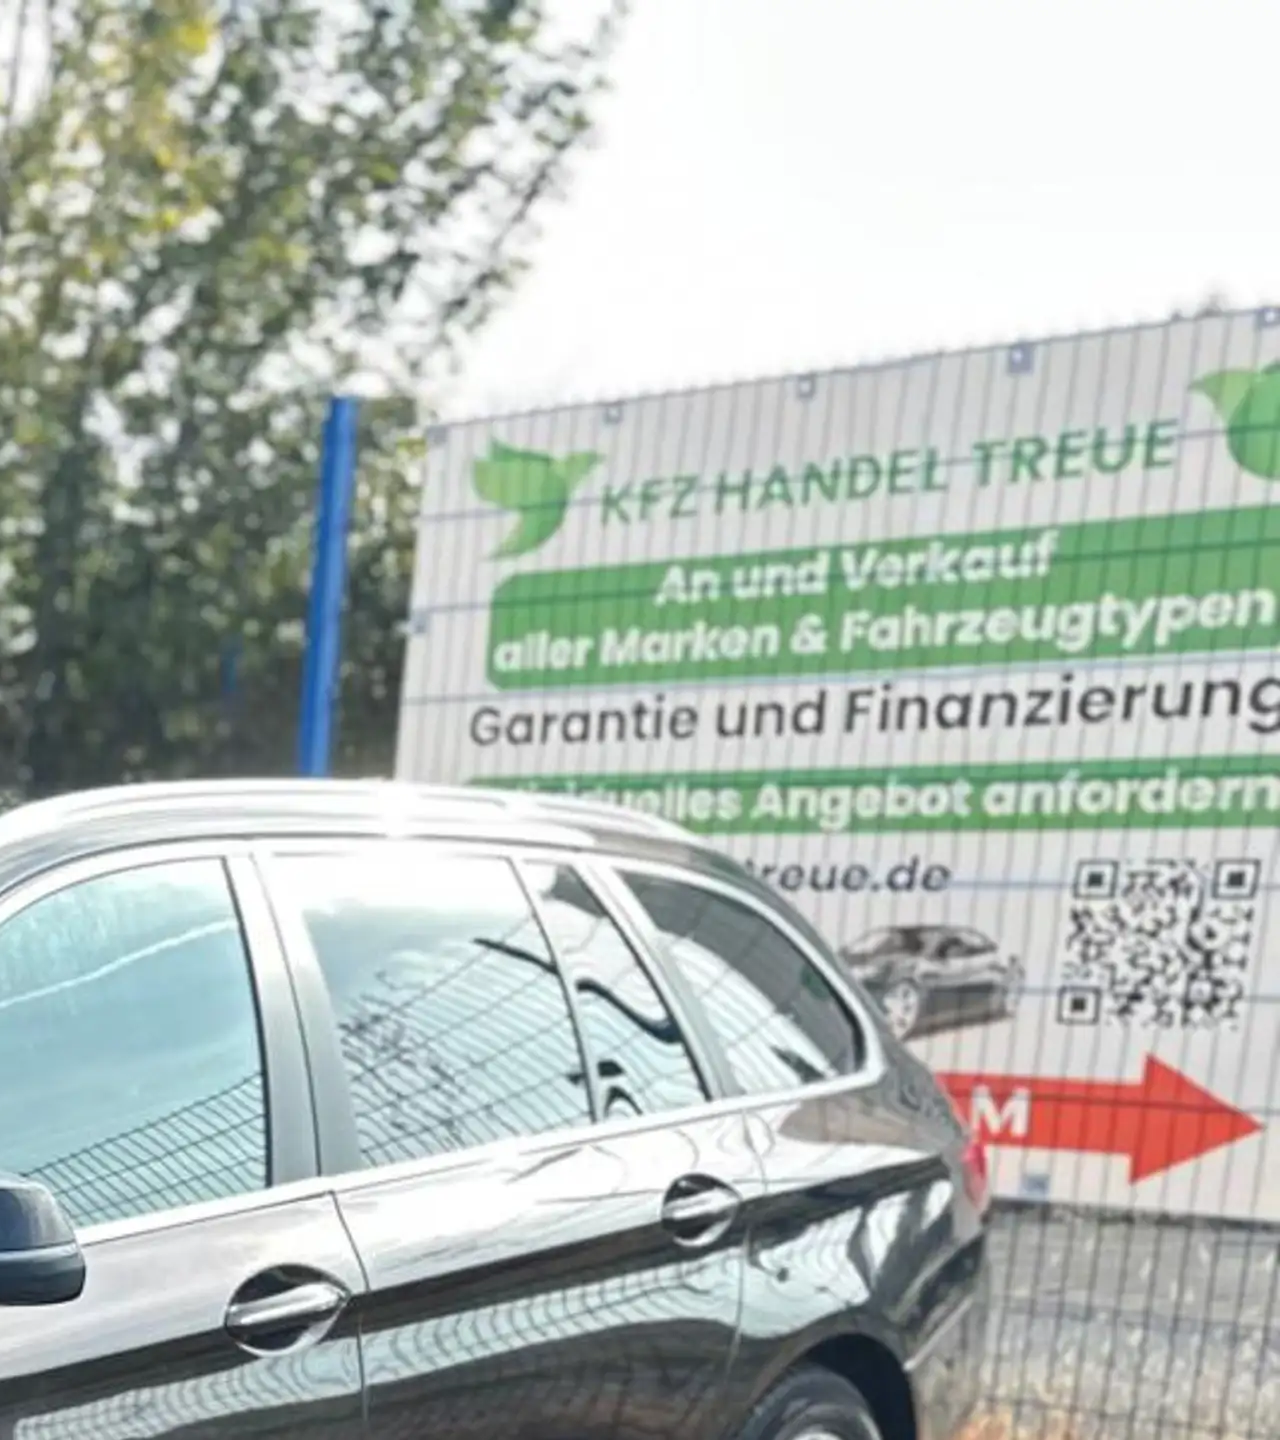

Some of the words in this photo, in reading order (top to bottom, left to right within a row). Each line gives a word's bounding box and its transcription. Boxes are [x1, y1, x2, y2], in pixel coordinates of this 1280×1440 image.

[600, 472, 698, 527] KFZ
[713, 450, 948, 512] HANDEL
[972, 420, 1179, 487] TREUE
[654, 562, 720, 606] An
[733, 552, 828, 600] und
[842, 534, 1058, 590] Verkauf
[493, 634, 593, 673] aller
[600, 620, 780, 667] Marken
[790, 615, 829, 653] &
[843, 589, 1277, 651] Fahrzeugtypen
[470, 695, 699, 746] Garantie
[715, 685, 827, 739] und
[845, 671, 1280, 734] Finanzierung
[749, 771, 971, 831] Angebot
[984, 768, 1280, 816] anfordern
